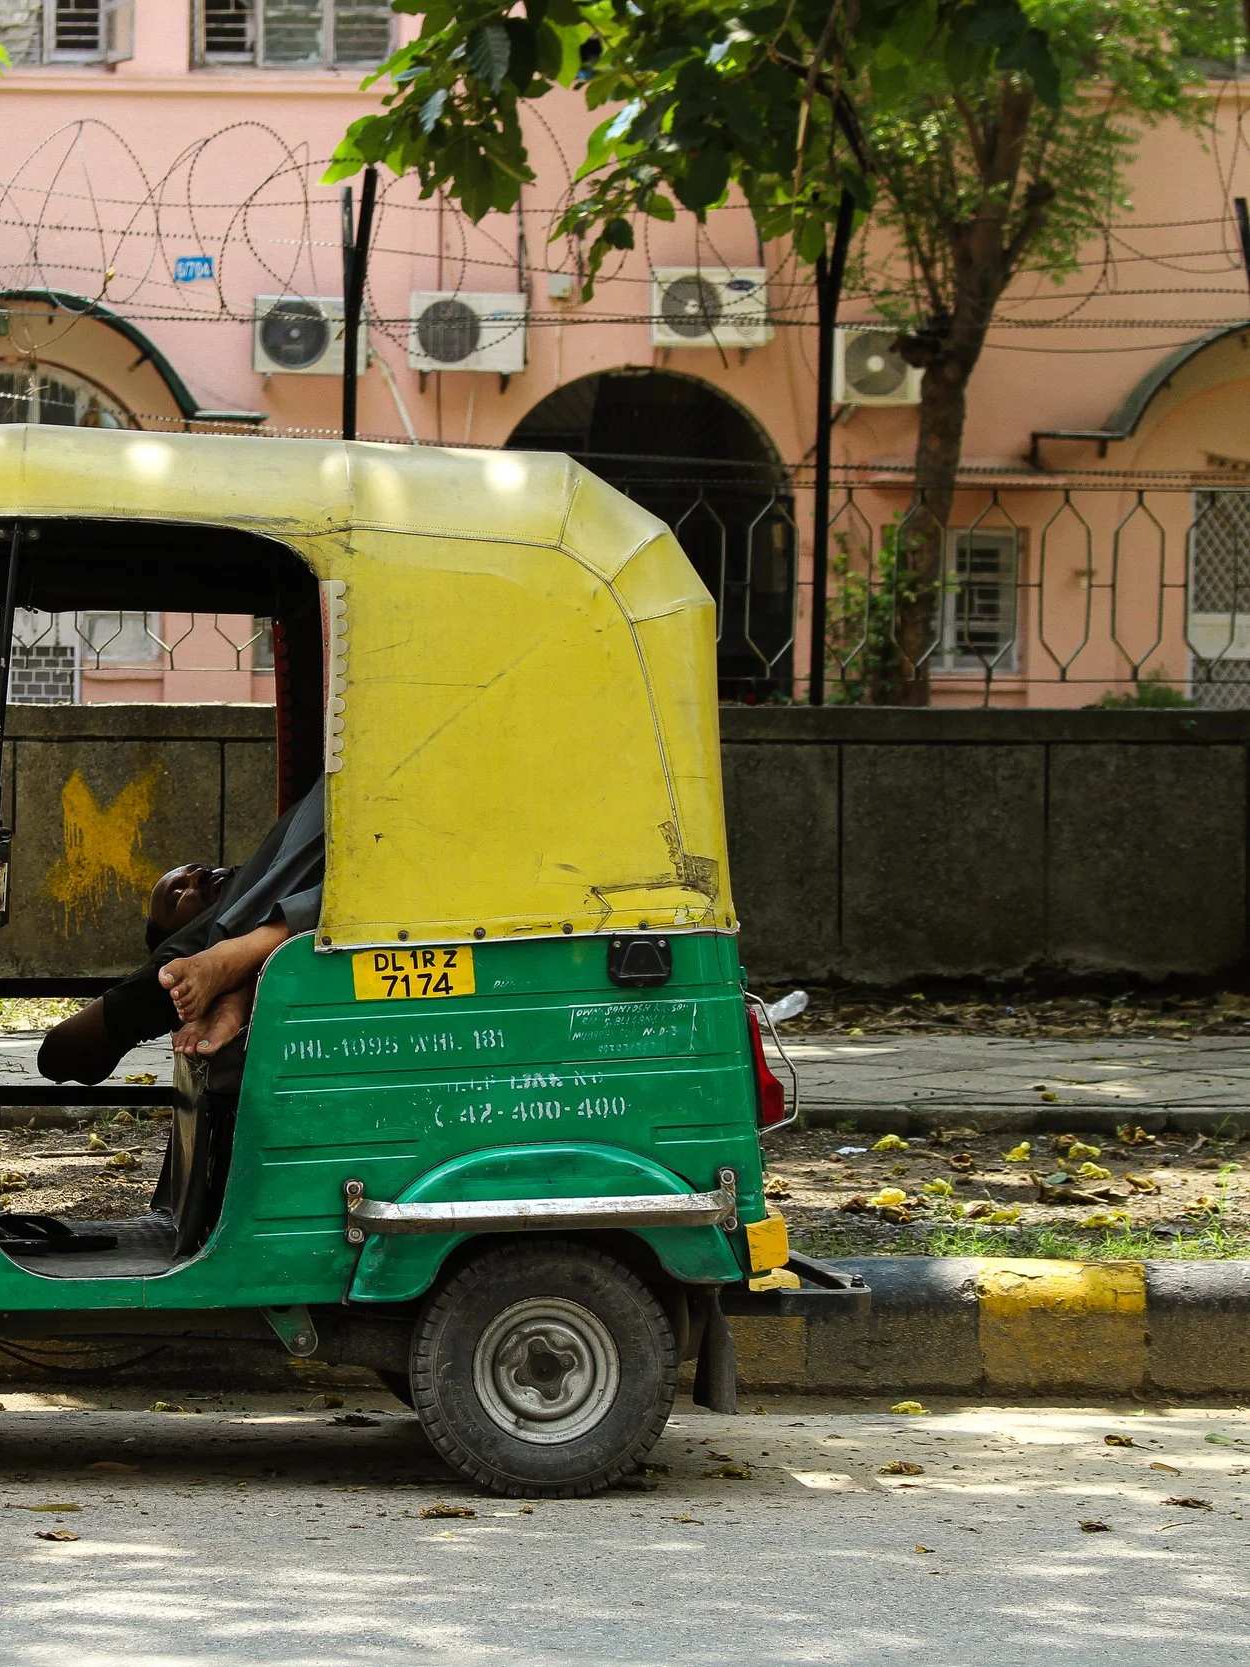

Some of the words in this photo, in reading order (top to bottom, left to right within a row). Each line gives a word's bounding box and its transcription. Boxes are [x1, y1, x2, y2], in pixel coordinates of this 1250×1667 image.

[374, 953, 405, 972] DL
[381, 972, 454, 997] 7174
[473, 1029, 505, 1050] 181
